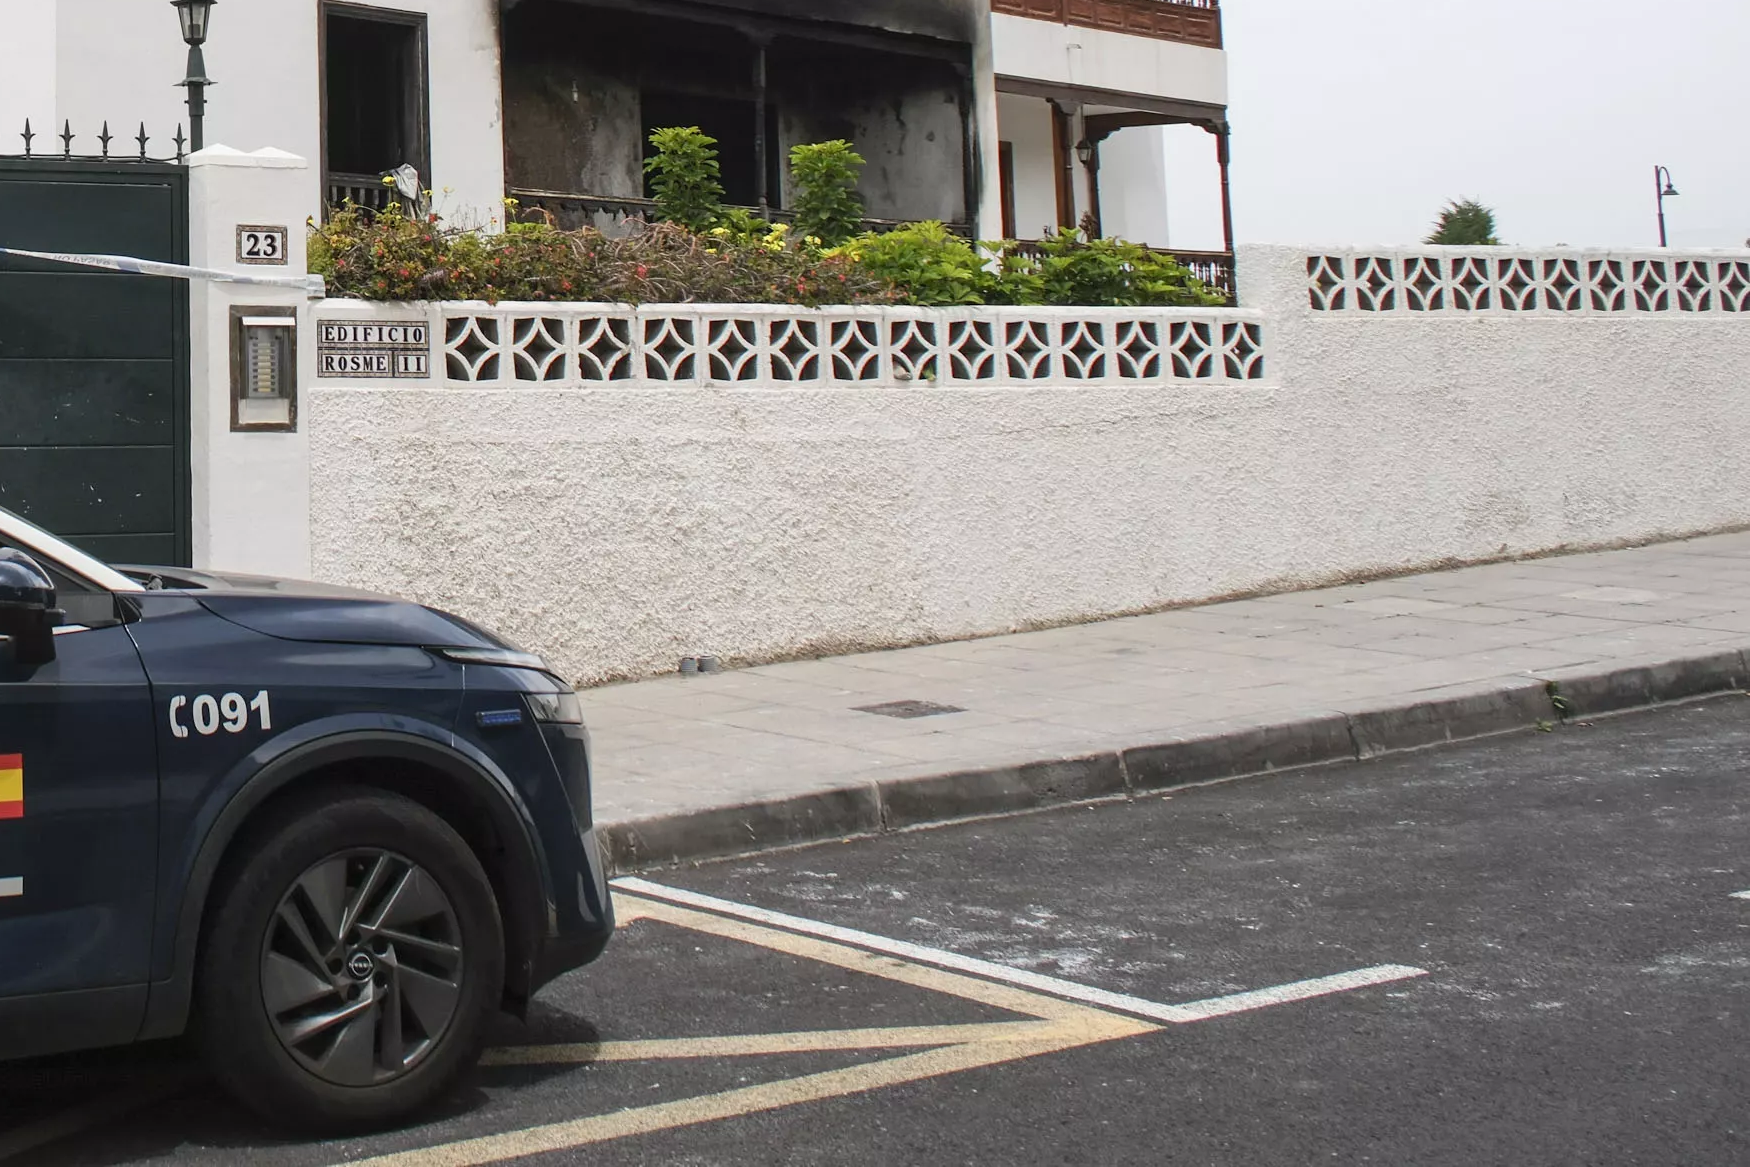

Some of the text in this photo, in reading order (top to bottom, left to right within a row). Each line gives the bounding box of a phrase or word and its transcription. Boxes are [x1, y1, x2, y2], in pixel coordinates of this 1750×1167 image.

[245, 234, 277, 257] 23
[324, 326, 423, 343] EDIFICIO
[324, 355, 422, 372] ROSME II
[192, 689, 271, 735] 091
